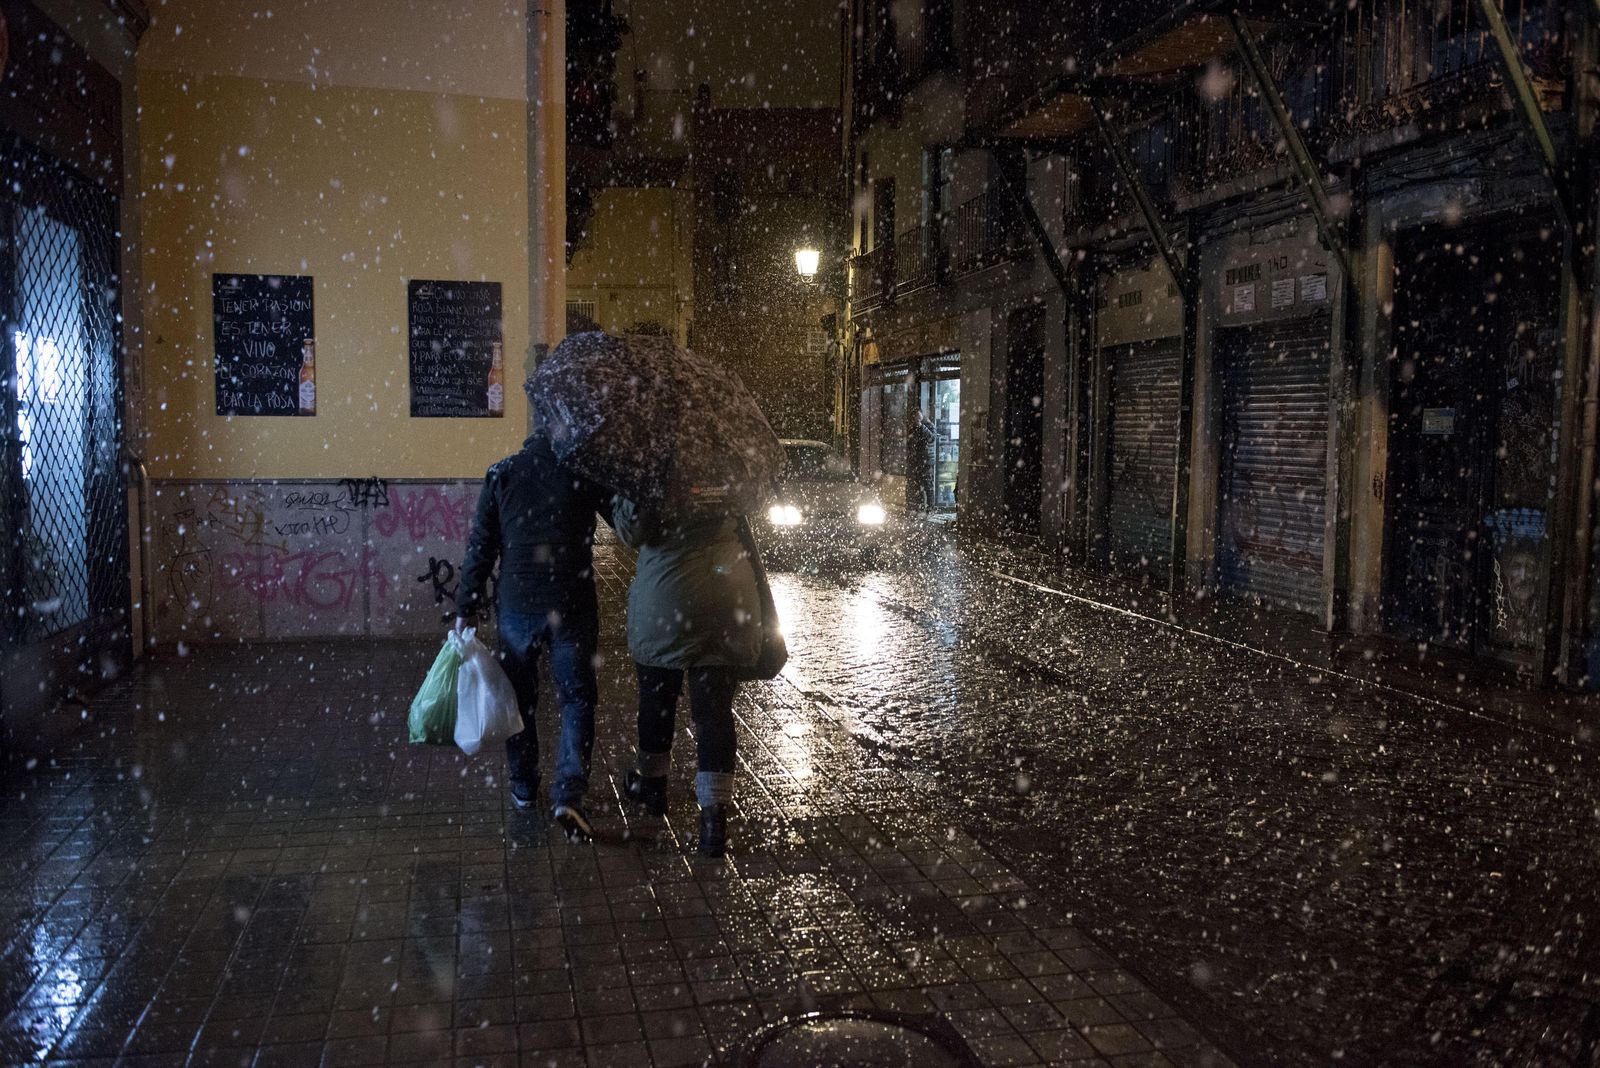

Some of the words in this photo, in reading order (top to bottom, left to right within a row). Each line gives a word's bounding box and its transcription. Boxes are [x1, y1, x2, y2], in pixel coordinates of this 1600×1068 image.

[220, 297, 259, 313] TENER
[221, 320, 241, 336] ES
[244, 320, 292, 335] TENER
[242, 340, 276, 358] VIVO
[223, 389, 245, 408] BAR
